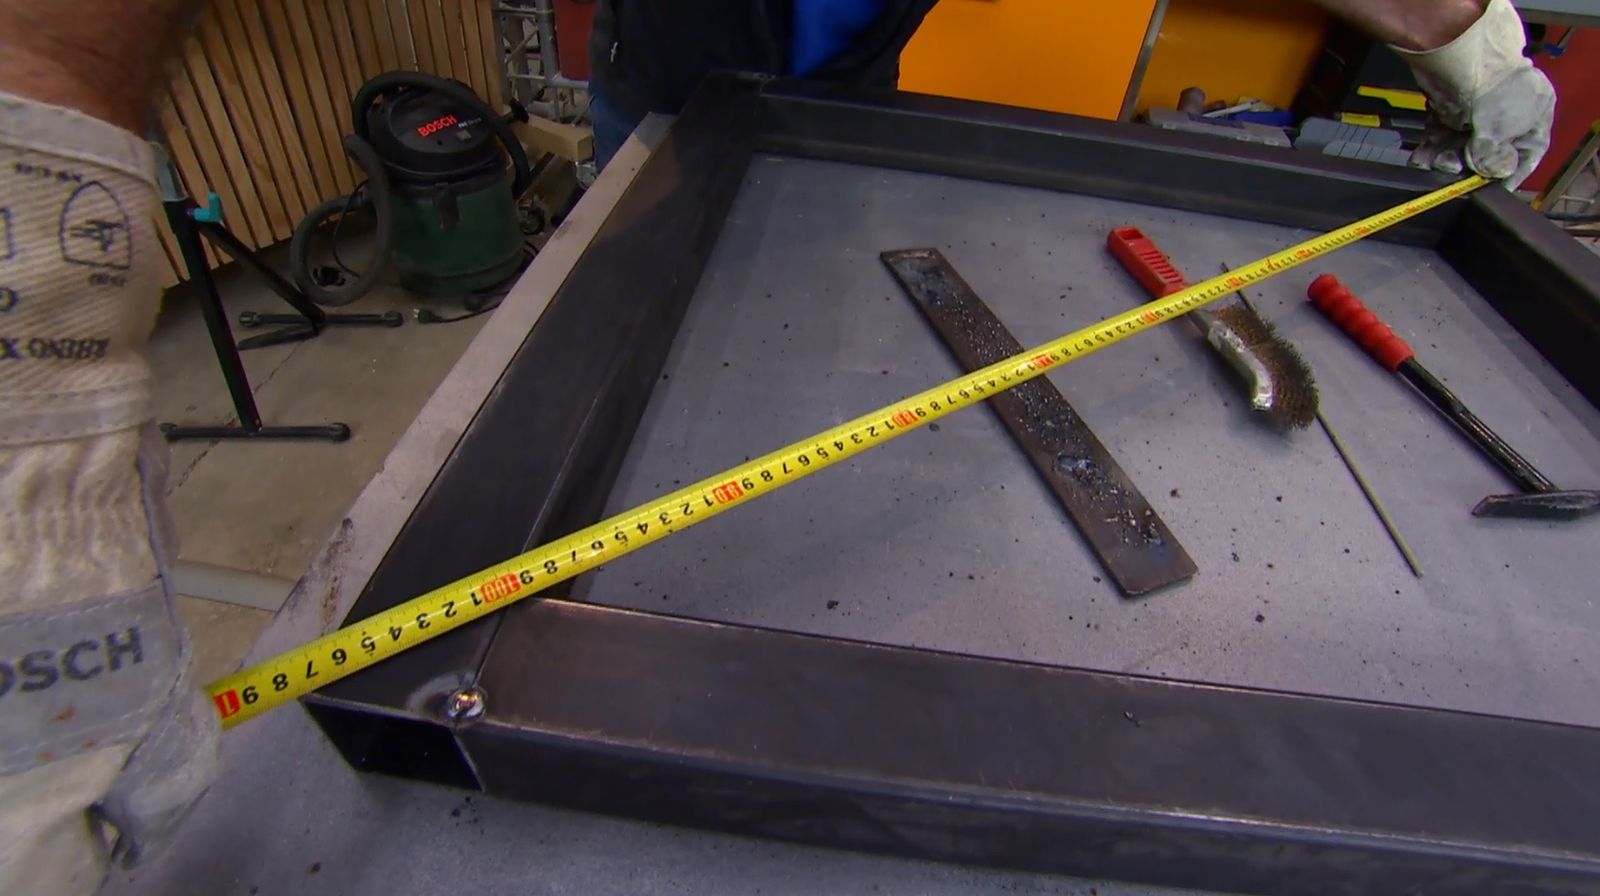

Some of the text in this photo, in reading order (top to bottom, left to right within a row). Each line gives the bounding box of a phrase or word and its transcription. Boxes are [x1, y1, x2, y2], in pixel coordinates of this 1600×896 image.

[418, 114, 458, 137] BOSCH
[973, 384, 985, 394] 5
[987, 379, 995, 387] 4
[946, 395, 956, 405] 7
[958, 390, 970, 399] 6
[914, 407, 926, 417] 9
[929, 401, 941, 410] 8
[866, 426, 879, 437] 2
[884, 420, 894, 430] 1
[850, 433, 862, 444] 3
[816, 447, 828, 458] 5
[833, 441, 843, 451] 4
[797, 454, 809, 465] 6
[782, 462, 792, 474] 7
[760, 470, 773, 481] 8
[741, 478, 754, 490] 9
[715, 482, 740, 505] 90
[703, 495, 713, 506] 1
[682, 502, 693, 515] 2
[658, 512, 672, 525] 3
[636, 522, 648, 535] 4
[614, 531, 628, 542] 5
[590, 538, 606, 553] 6
[543, 560, 557, 574] 8
[519, 570, 533, 584] 9
[482, 575, 517, 603] 100
[470, 592, 482, 606] 1
[442, 600, 457, 617] 2
[415, 612, 430, 629] 3
[388, 626, 402, 641] 4
[360, 636, 375, 653] 5
[331, 648, 346, 665] 6
[305, 660, 318, 679] 7
[272, 673, 288, 691] 8
[242, 686, 258, 704] 9
